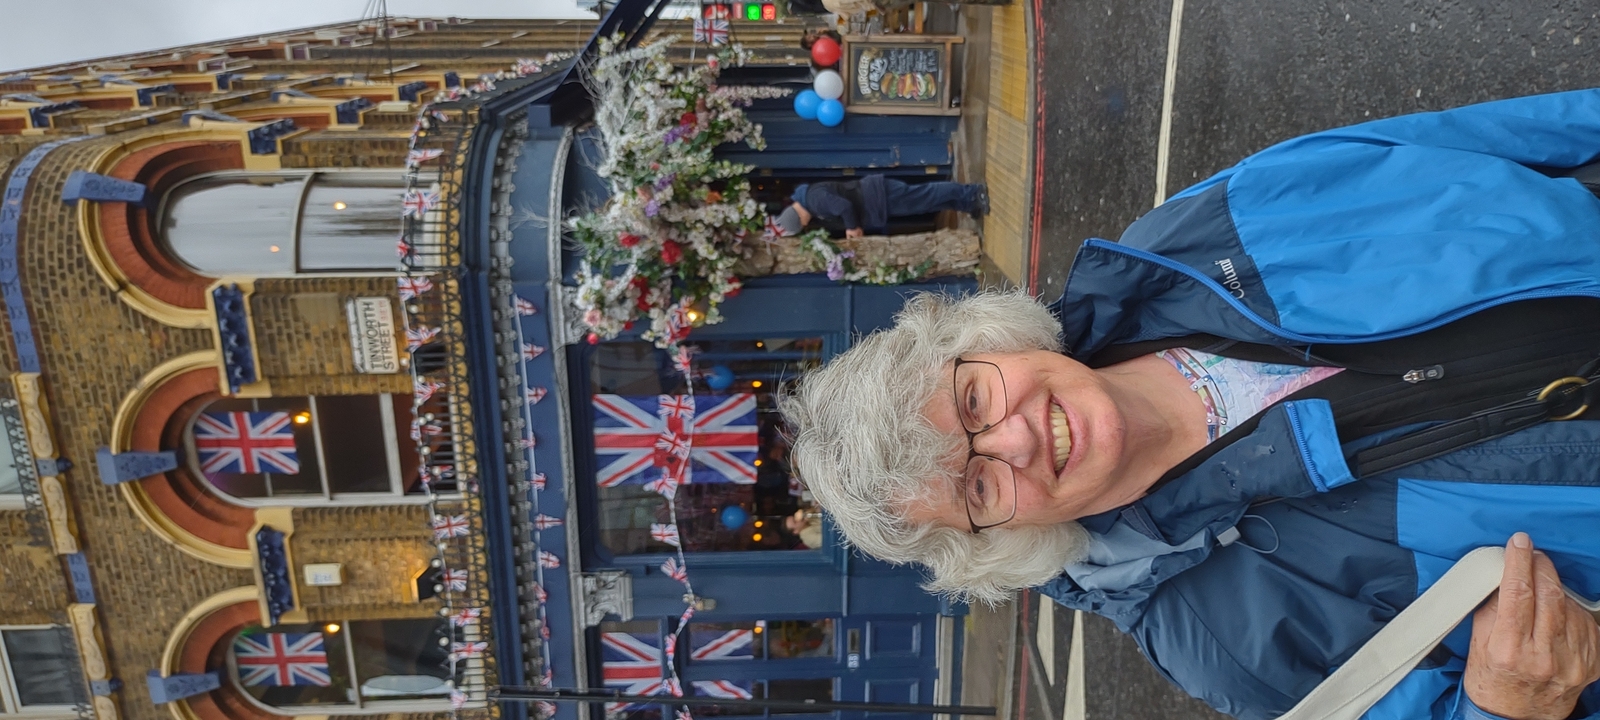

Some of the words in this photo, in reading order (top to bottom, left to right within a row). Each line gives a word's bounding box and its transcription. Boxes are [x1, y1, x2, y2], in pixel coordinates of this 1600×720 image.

[858, 55, 872, 94] BURGER
[363, 302, 382, 369] TINWORTH
[378, 322, 394, 369] STREET
